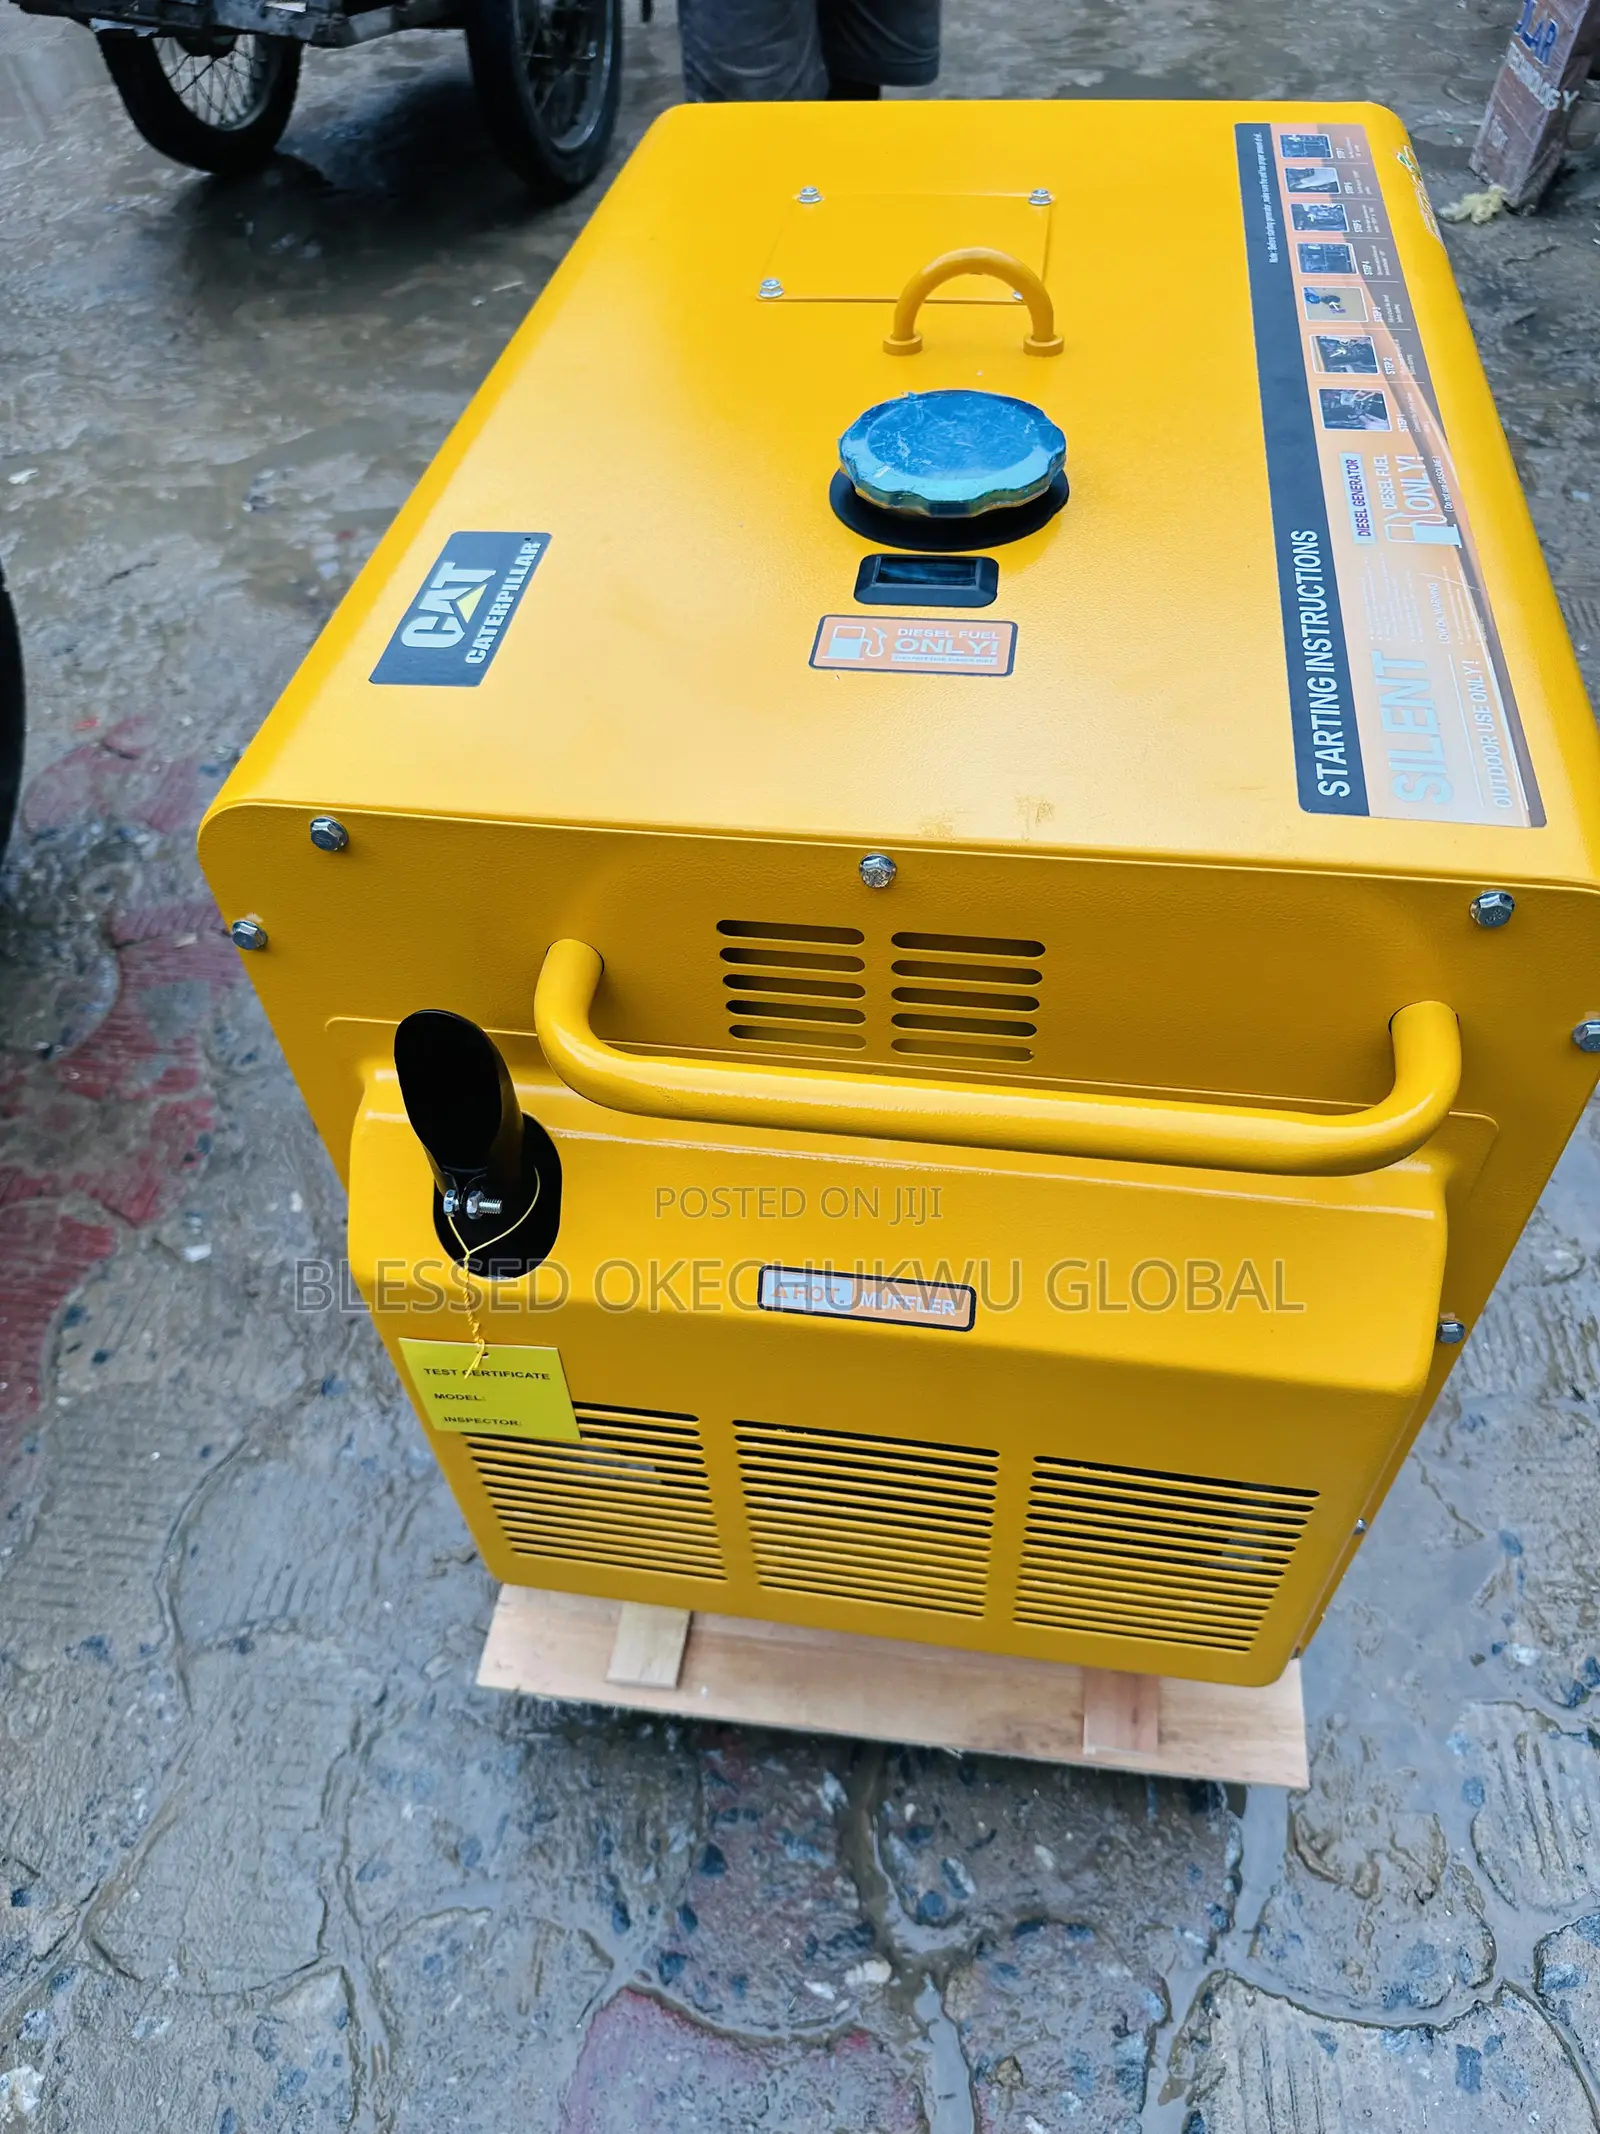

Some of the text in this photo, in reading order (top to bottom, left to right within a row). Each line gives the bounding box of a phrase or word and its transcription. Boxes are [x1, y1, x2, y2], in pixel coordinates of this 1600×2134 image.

[1373, 310, 1384, 322] STEP
[1384, 361, 1396, 375] STEP
[1397, 418, 1409, 432] STEP
[1373, 455, 1398, 509] DIESEL FUEL
[1395, 456, 1436, 511] ONLY!
[1345, 459, 1371, 536] DIESEL GENERATOR
[401, 562, 497, 648] CAT
[464, 541, 542, 664] CATERPILLAR
[1427, 583, 1444, 615] WARNING
[894, 638, 999, 656] ONLY!
[897, 628, 1001, 640] DIESEL FUEL
[1290, 530, 1350, 798] STARTING INSTRUCTIONS
[1462, 660, 1488, 702] ONLY!
[1371, 650, 1452, 804] SILENT
[1473, 706, 1495, 732] USE
[1480, 735, 1513, 808] OUTDOOR
[860, 1291, 957, 1316] MUFFLER
[423, 1367, 551, 1381] TEST CERTIFICATE
[434, 1392, 486, 1402] MODEL:
[443, 1416, 523, 1427] INSPECTOR:
